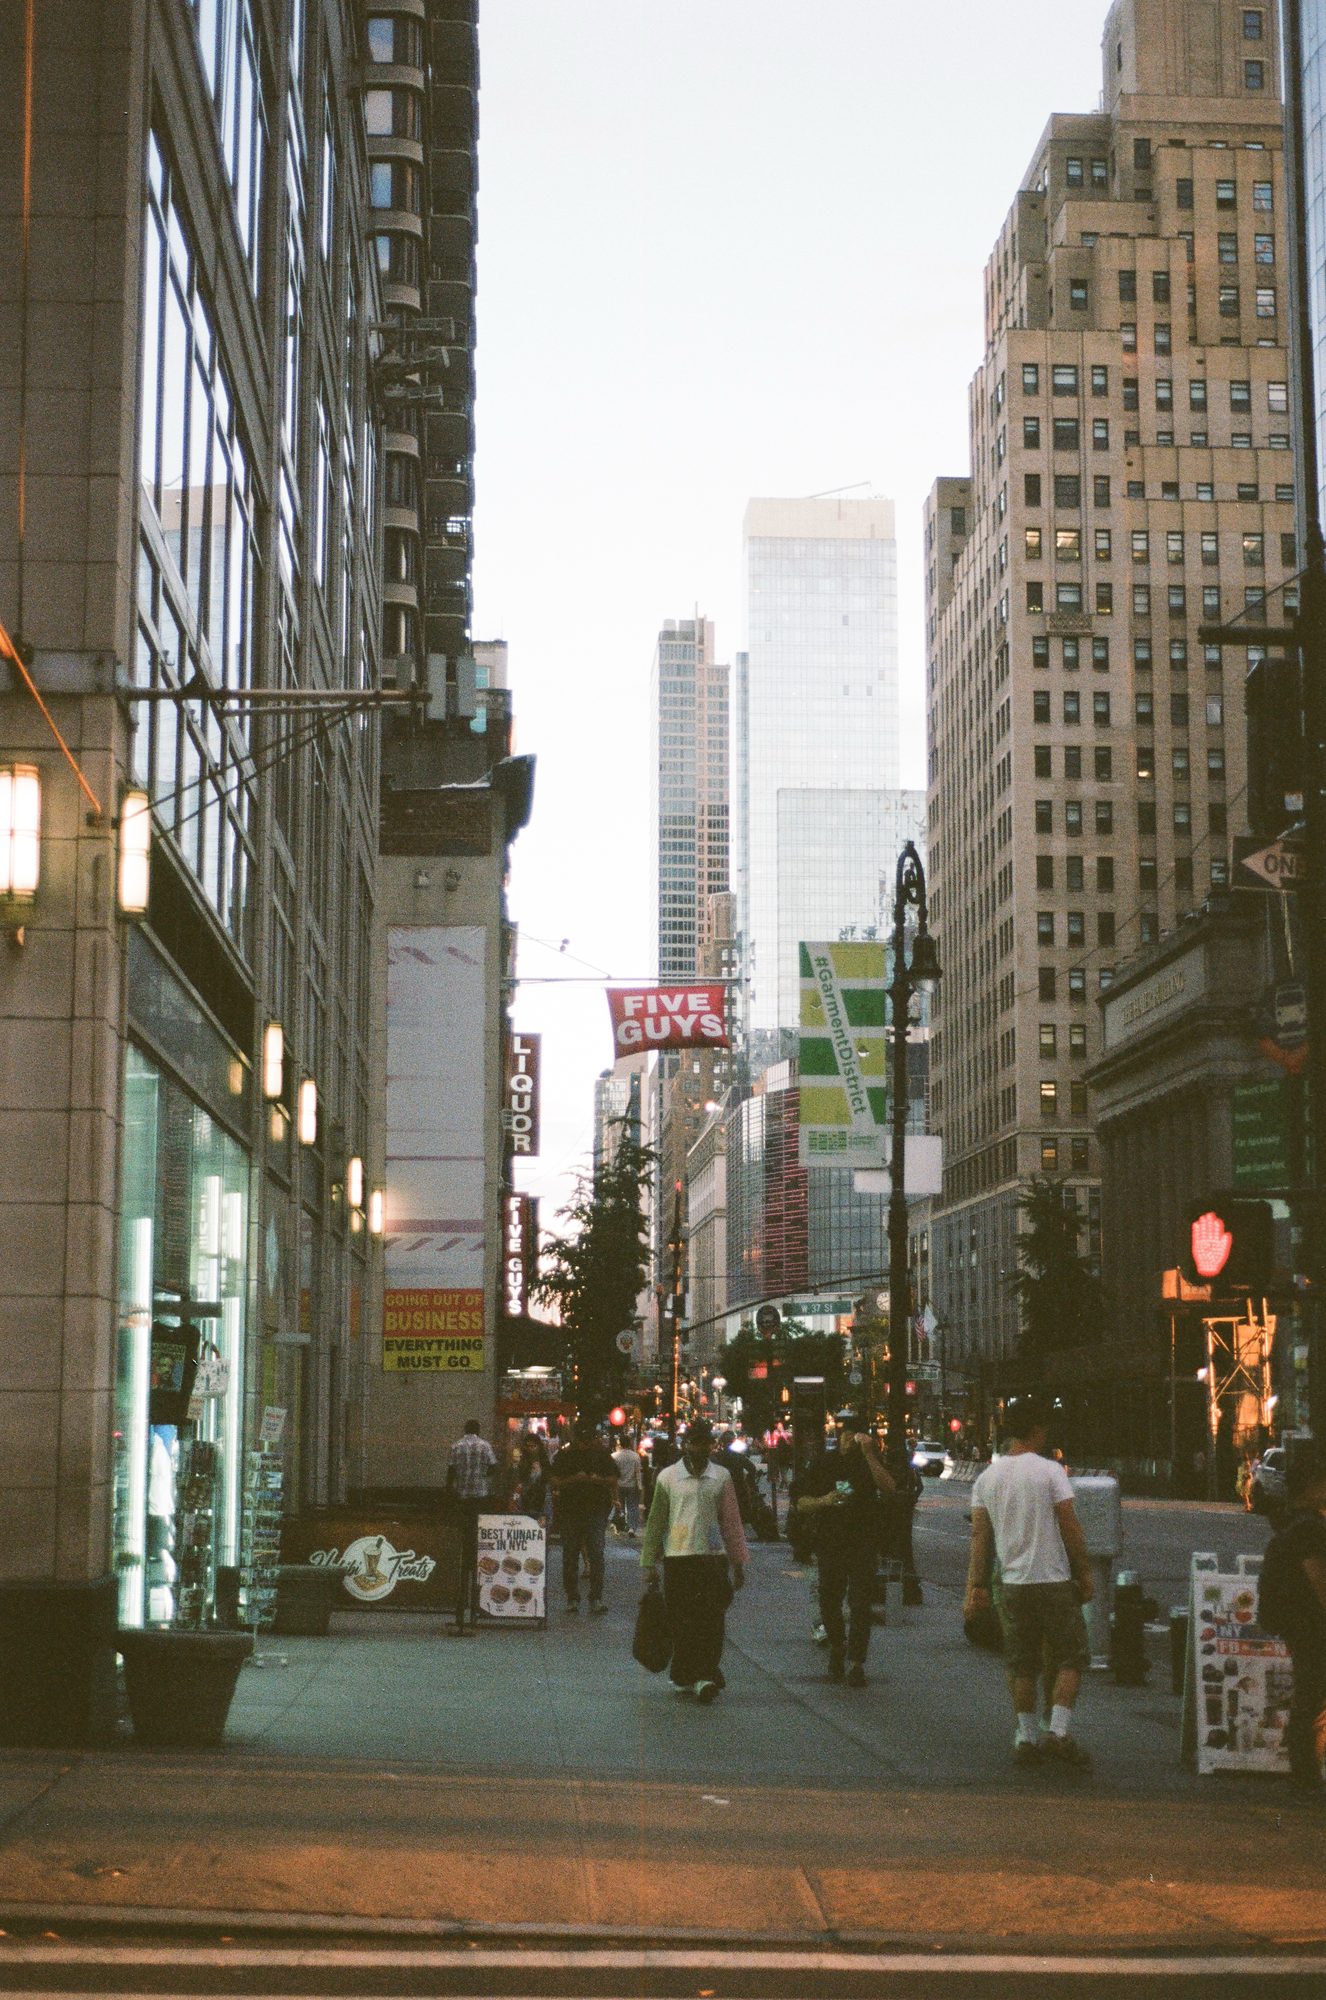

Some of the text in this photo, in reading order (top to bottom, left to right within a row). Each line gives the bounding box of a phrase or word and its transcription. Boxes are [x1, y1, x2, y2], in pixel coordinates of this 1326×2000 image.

[1264, 853, 1297, 875] ON
[623, 993, 711, 1016] FIVE
[617, 1014, 723, 1045] GUYS
[814, 956, 866, 1114] #GarmentDistrict
[510, 1036, 533, 1152] LIQUOR
[508, 1197, 523, 1314] FIVE GUYS
[385, 1293, 483, 1307] GOING OUT OF
[811, 1303, 820, 1313] 37
[385, 1311, 483, 1330] BUSINESS
[385, 1338, 483, 1351] EVERYTHING
[397, 1355, 470, 1368] MUST GO
[481, 1529, 543, 1541] BEST KUNAFA
[497, 1540, 506, 1550] IN
[509, 1540, 528, 1550] NYC
[388, 1552, 433, 1583] Treats
